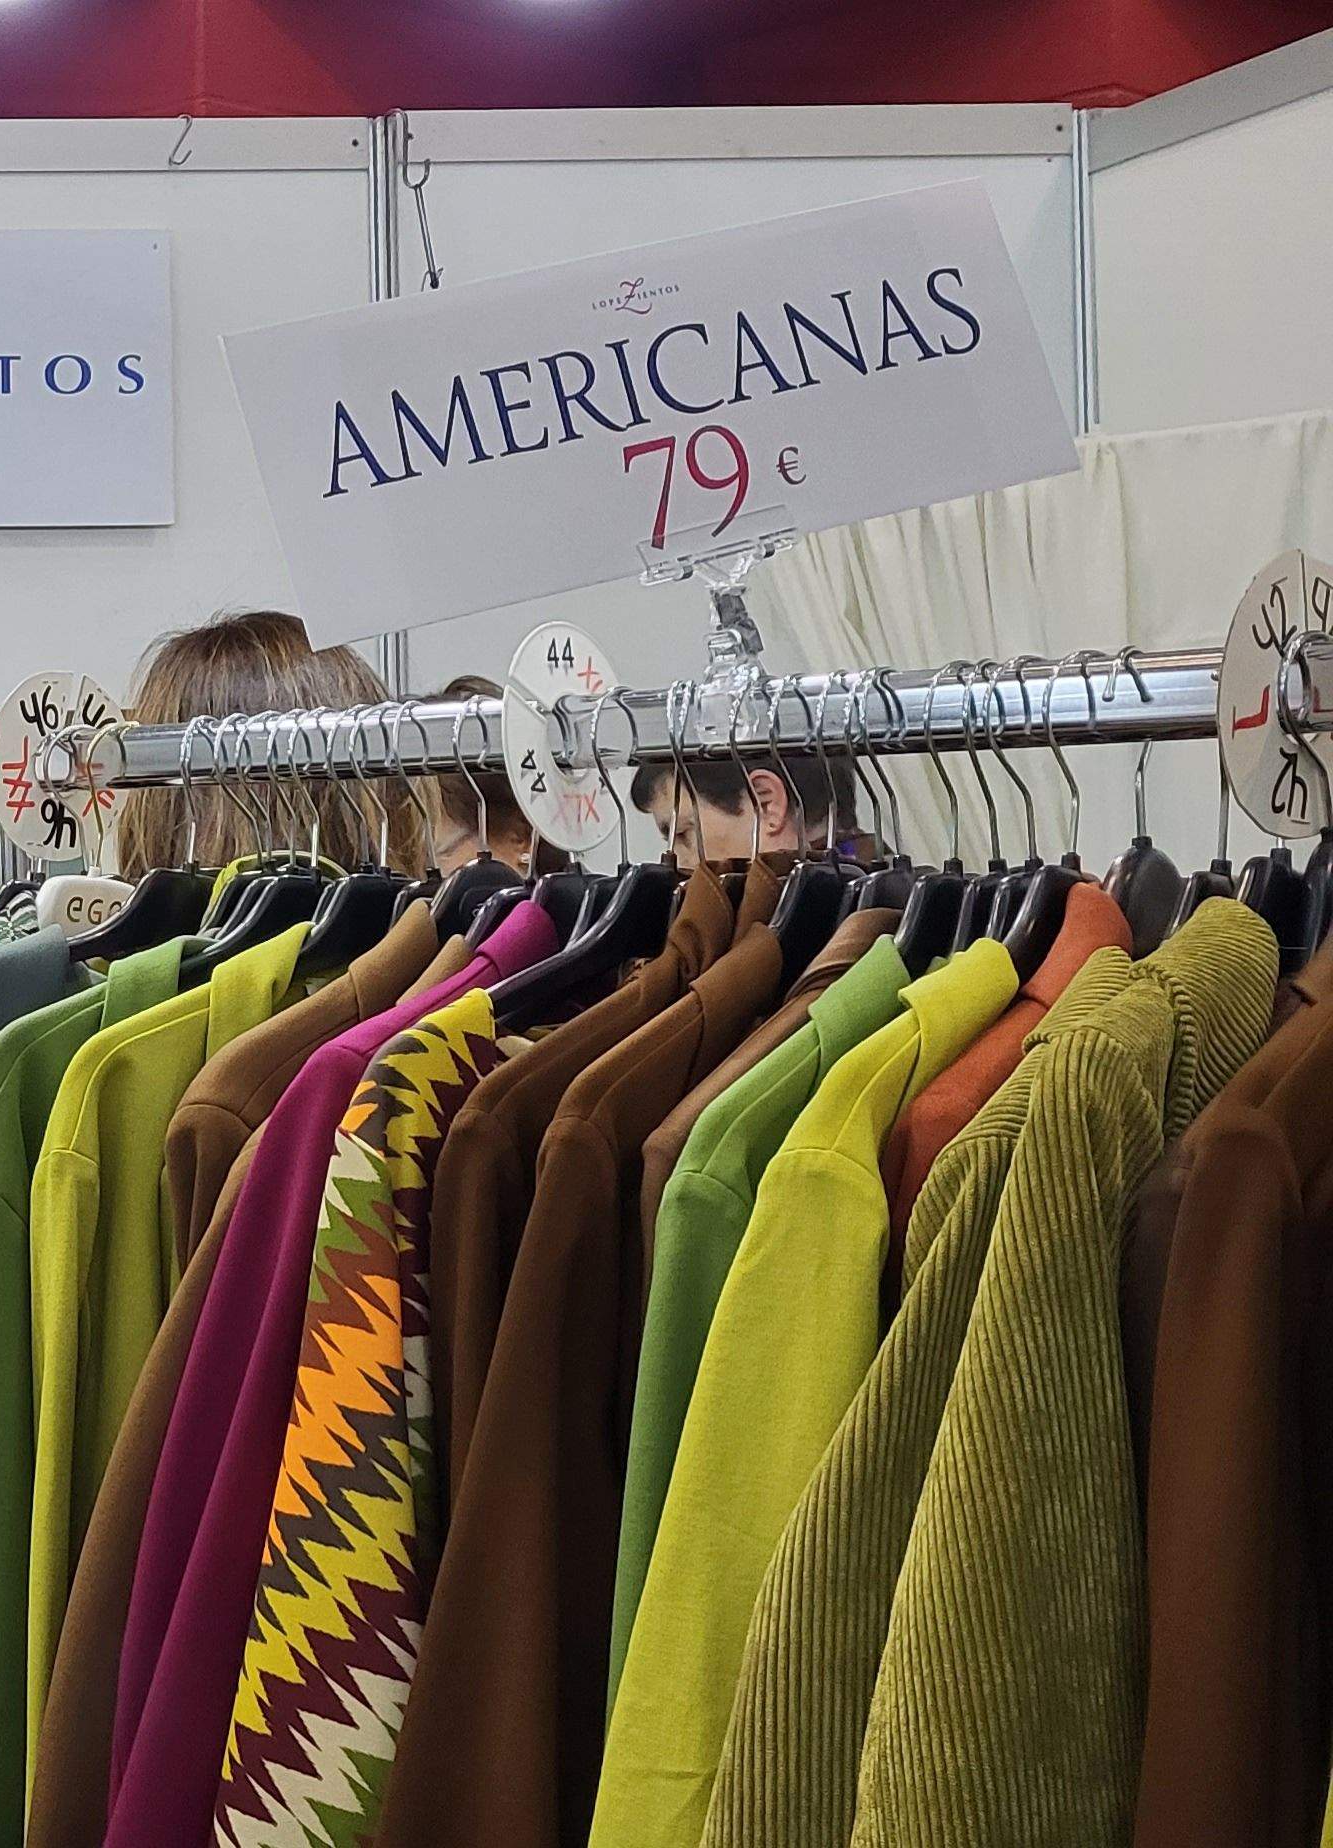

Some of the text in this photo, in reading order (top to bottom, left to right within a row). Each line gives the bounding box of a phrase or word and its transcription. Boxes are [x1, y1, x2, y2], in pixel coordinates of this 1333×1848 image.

[322, 267, 983, 498] AMERICANAS
[622, 425, 807, 549] 79 €
[546, 636, 575, 669] 44
[19, 685, 59, 737] 46
